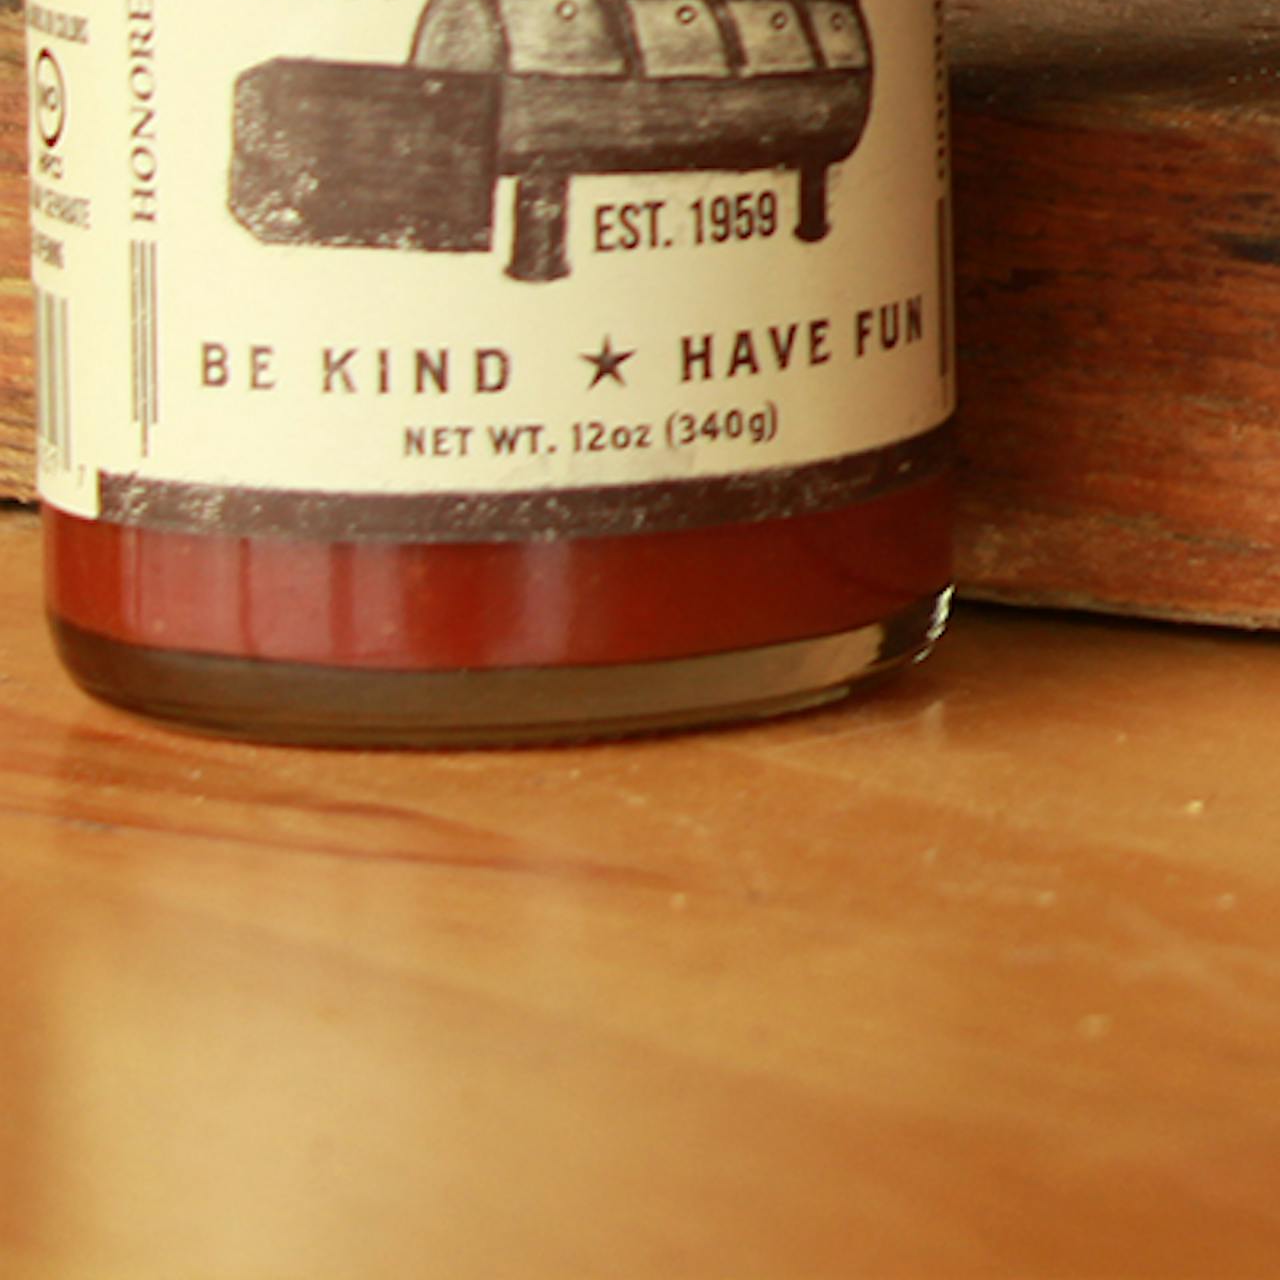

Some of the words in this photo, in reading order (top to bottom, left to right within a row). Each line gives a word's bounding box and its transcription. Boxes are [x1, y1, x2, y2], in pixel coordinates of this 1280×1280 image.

[594, 201, 673, 253] EST.
[690, 191, 779, 244] 1959
[202, 342, 275, 390] BE
[321, 347, 512, 395] KIND
[681, 318, 831, 382] HAVE
[855, 296, 925, 359] FUN
[404, 426, 473, 458] NET
[487, 423, 557, 455] WT.
[572, 421, 651, 452] 12oz
[664, 403, 779, 446] (340g)
